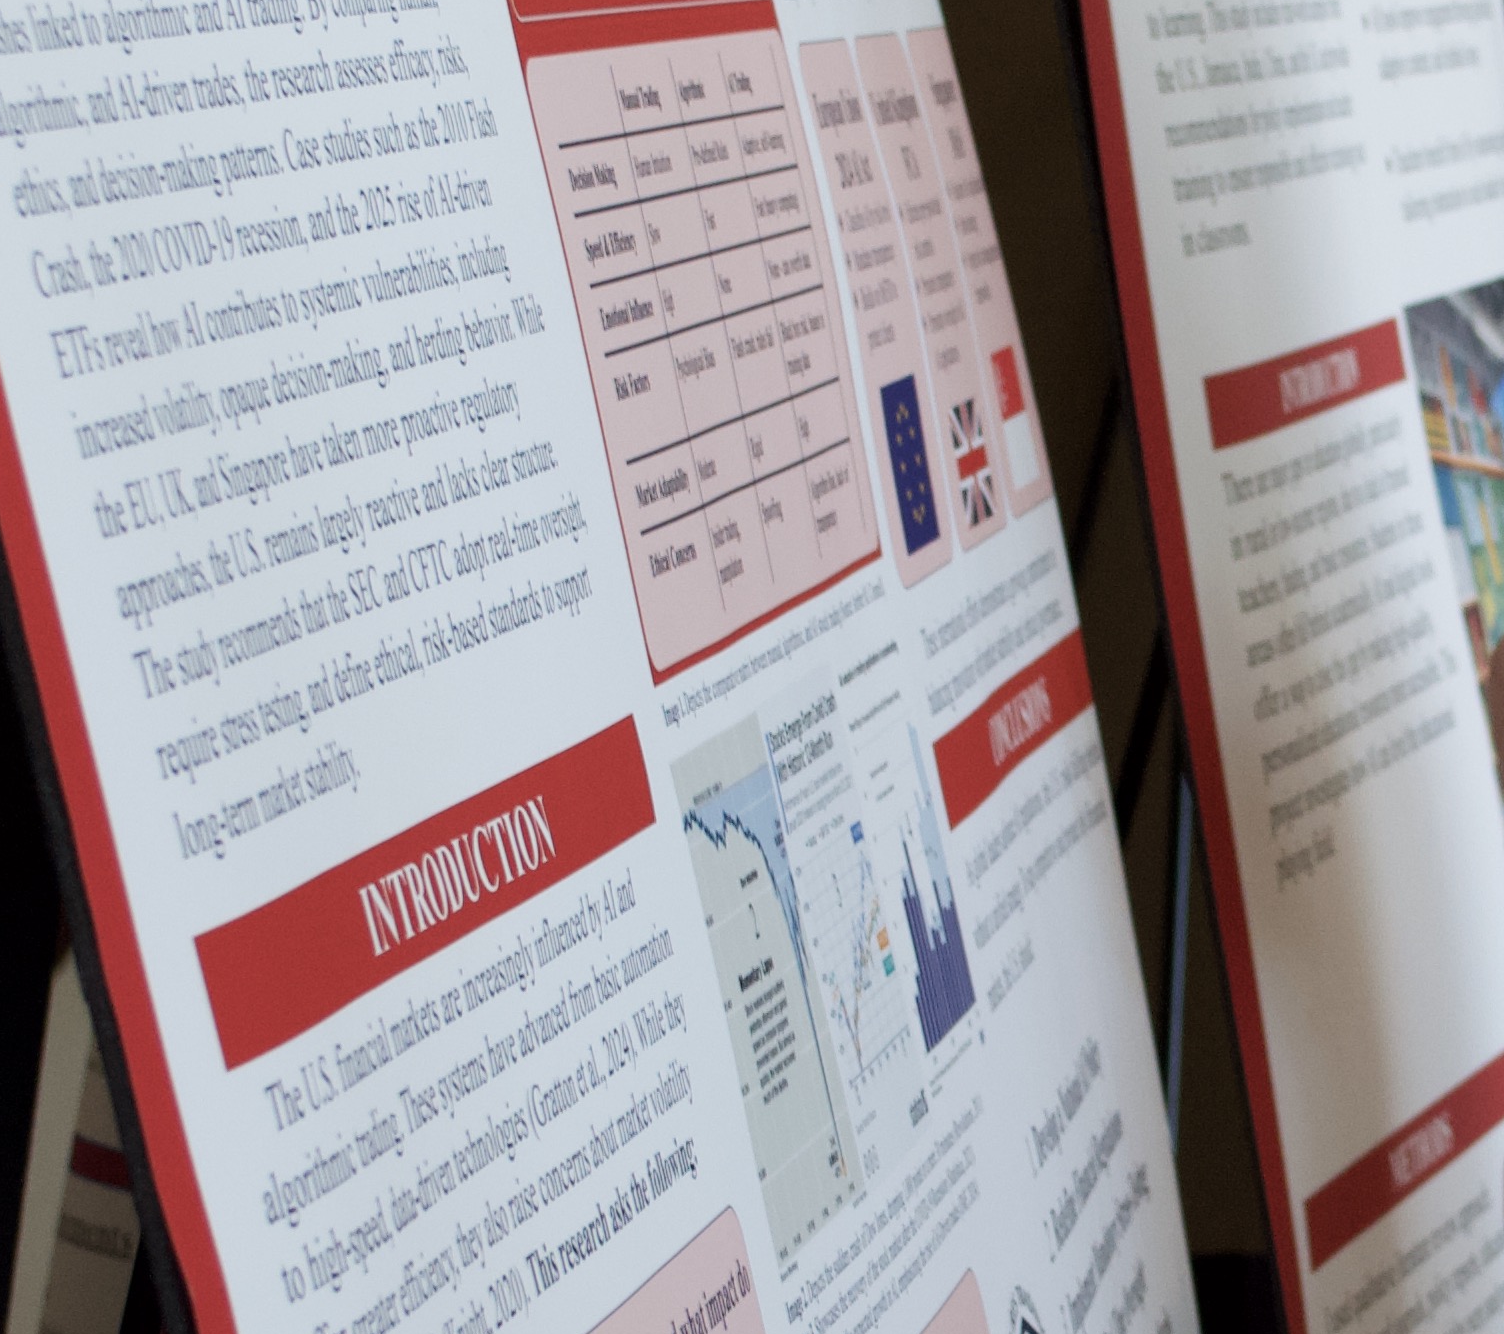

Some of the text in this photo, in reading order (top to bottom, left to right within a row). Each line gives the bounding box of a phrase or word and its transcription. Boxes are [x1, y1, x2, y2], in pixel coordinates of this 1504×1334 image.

[130, 646, 177, 700] The
[175, 628, 221, 687] study
[216, 595, 303, 669] recommends
[298, 588, 331, 635] that
[324, 579, 352, 625] the
[346, 563, 383, 616] SEC
[382, 553, 411, 604] and
[407, 537, 453, 593] CFTC
[452, 531, 490, 582] adopt
[486, 511, 541, 564] real-time
[357, 794, 556, 957] INTRODUCTION
[262, 866, 637, 1132] The U.S. financial markets are increasingly influenced by AI and
[524, 1242, 560, 1297] This
[556, 1202, 611, 1275] research
[608, 1186, 633, 1234] asks
[629, 1171, 651, 1215] the
[701, 1271, 740, 1331] impact
[734, 1257, 752, 1299] do
